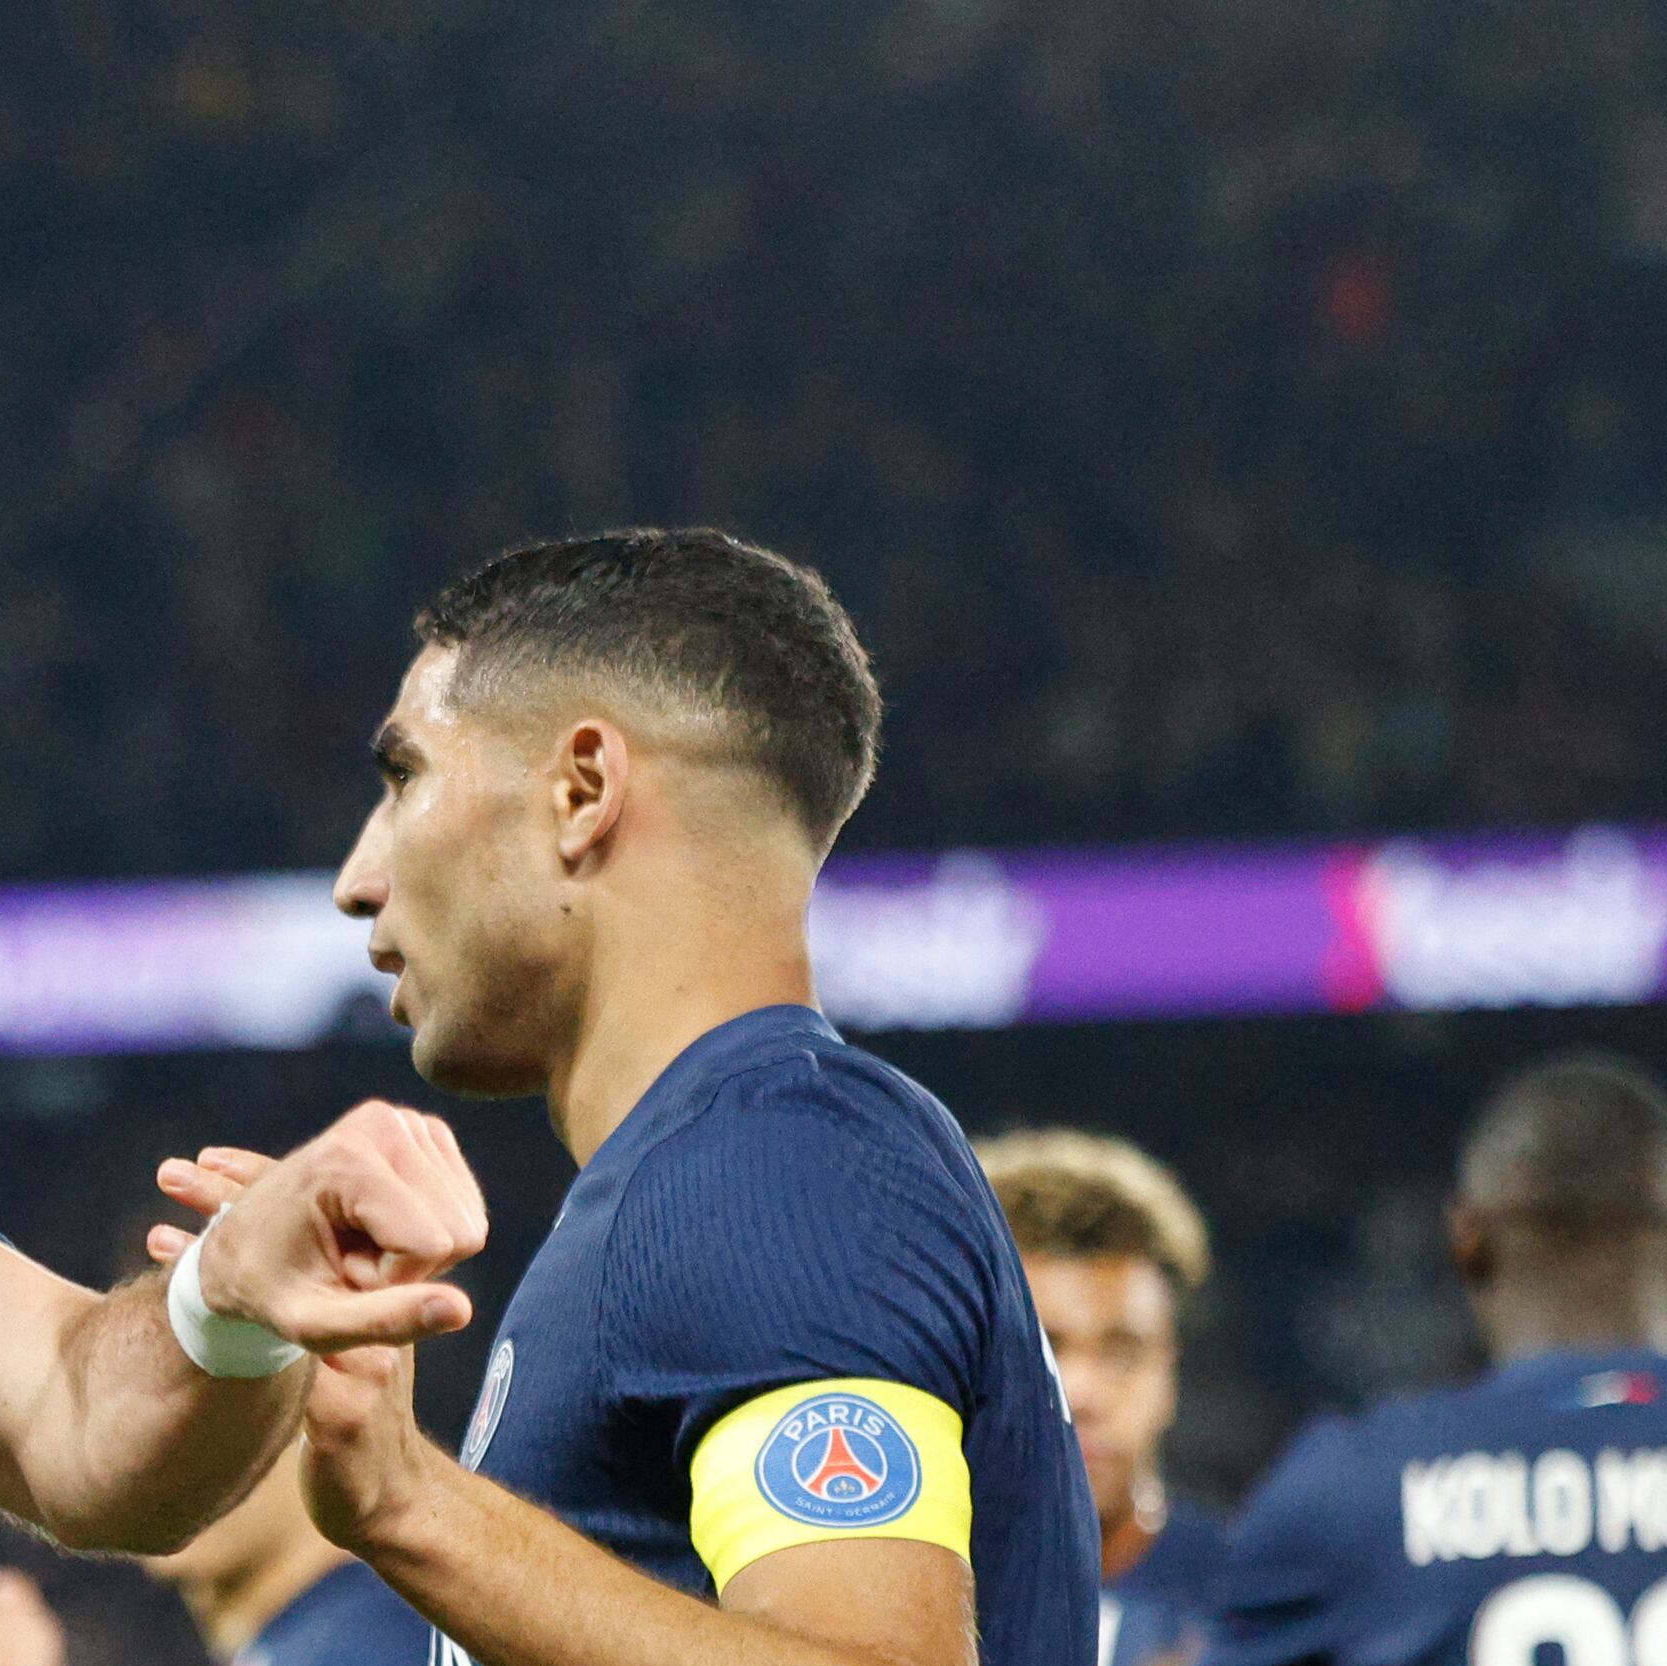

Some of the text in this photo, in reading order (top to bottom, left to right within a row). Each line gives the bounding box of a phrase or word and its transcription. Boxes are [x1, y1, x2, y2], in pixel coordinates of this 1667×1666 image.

[782, 1403, 886, 1442] PARIS
[795, 1496, 834, 1517] SAINT
[1401, 1447, 1594, 1567] KOLO
